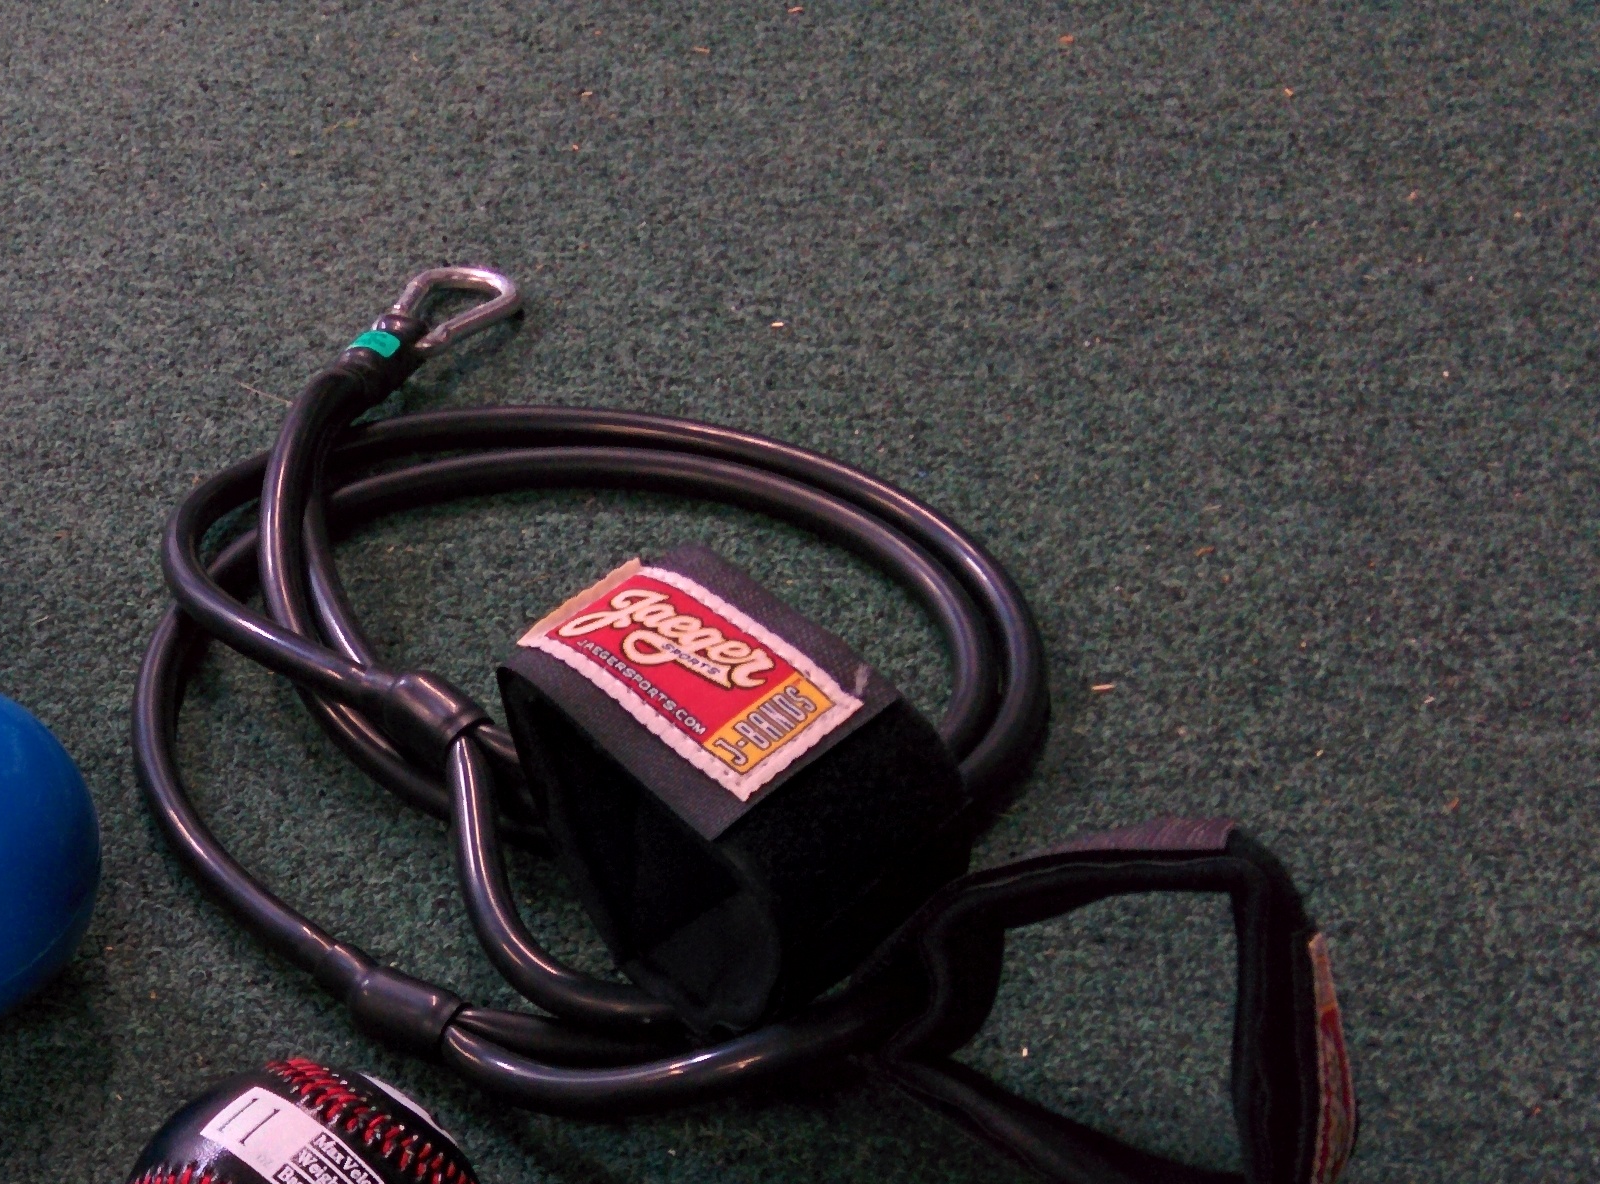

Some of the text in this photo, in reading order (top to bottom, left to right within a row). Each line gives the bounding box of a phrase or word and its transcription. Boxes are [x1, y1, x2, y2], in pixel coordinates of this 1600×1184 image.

[557, 588, 777, 692] Jaeger
[577, 639, 706, 736] JAEGERSPORTS.COM
[711, 684, 818, 768] J-BANDS
